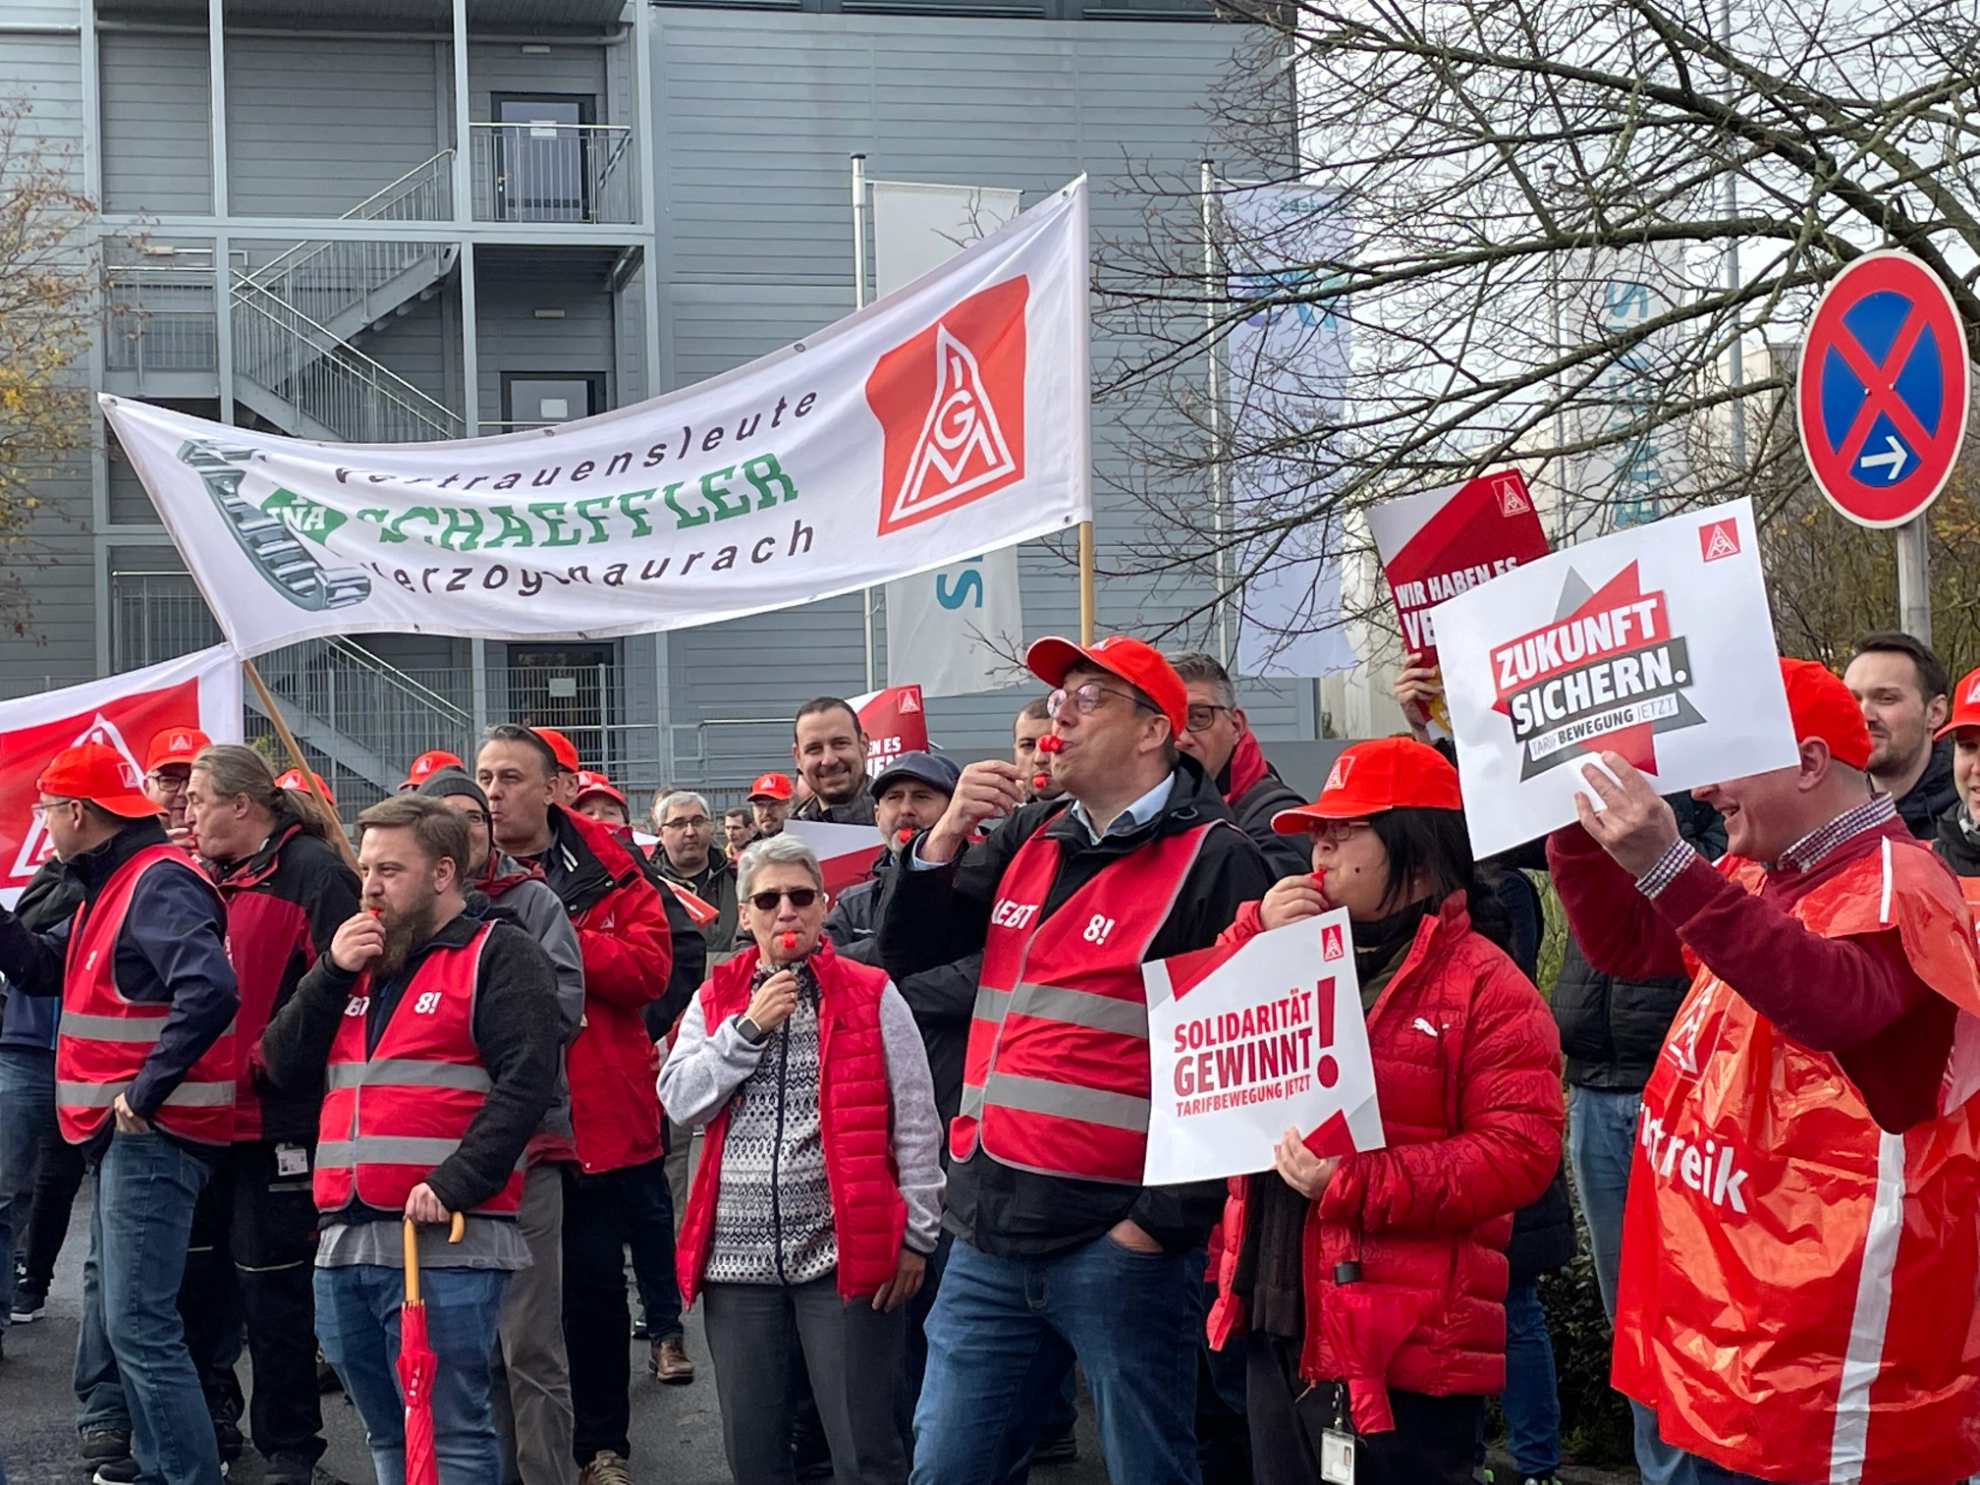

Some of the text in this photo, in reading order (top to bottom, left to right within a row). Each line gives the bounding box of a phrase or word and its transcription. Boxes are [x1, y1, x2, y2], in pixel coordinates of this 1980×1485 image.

[356, 452, 799, 551] SCHAEFFLER
[361, 519, 814, 596] erzognaurach
[1395, 581, 1427, 609] WIR
[1428, 563, 1492, 601] HABEN
[1496, 598, 1658, 690] ZUKUNFT
[1511, 646, 1687, 736] SICHERN.
[1637, 697, 1675, 722] JETZT
[884, 736, 901, 754] ES
[1083, 914, 1115, 945] 8!
[414, 991, 442, 1015] 8!
[1174, 988, 1312, 1054] SOLIDARITÄT
[1173, 1026, 1313, 1097] GEWINNT
[1176, 1074, 1311, 1118] TARIFBEWEGUNG JETZT
